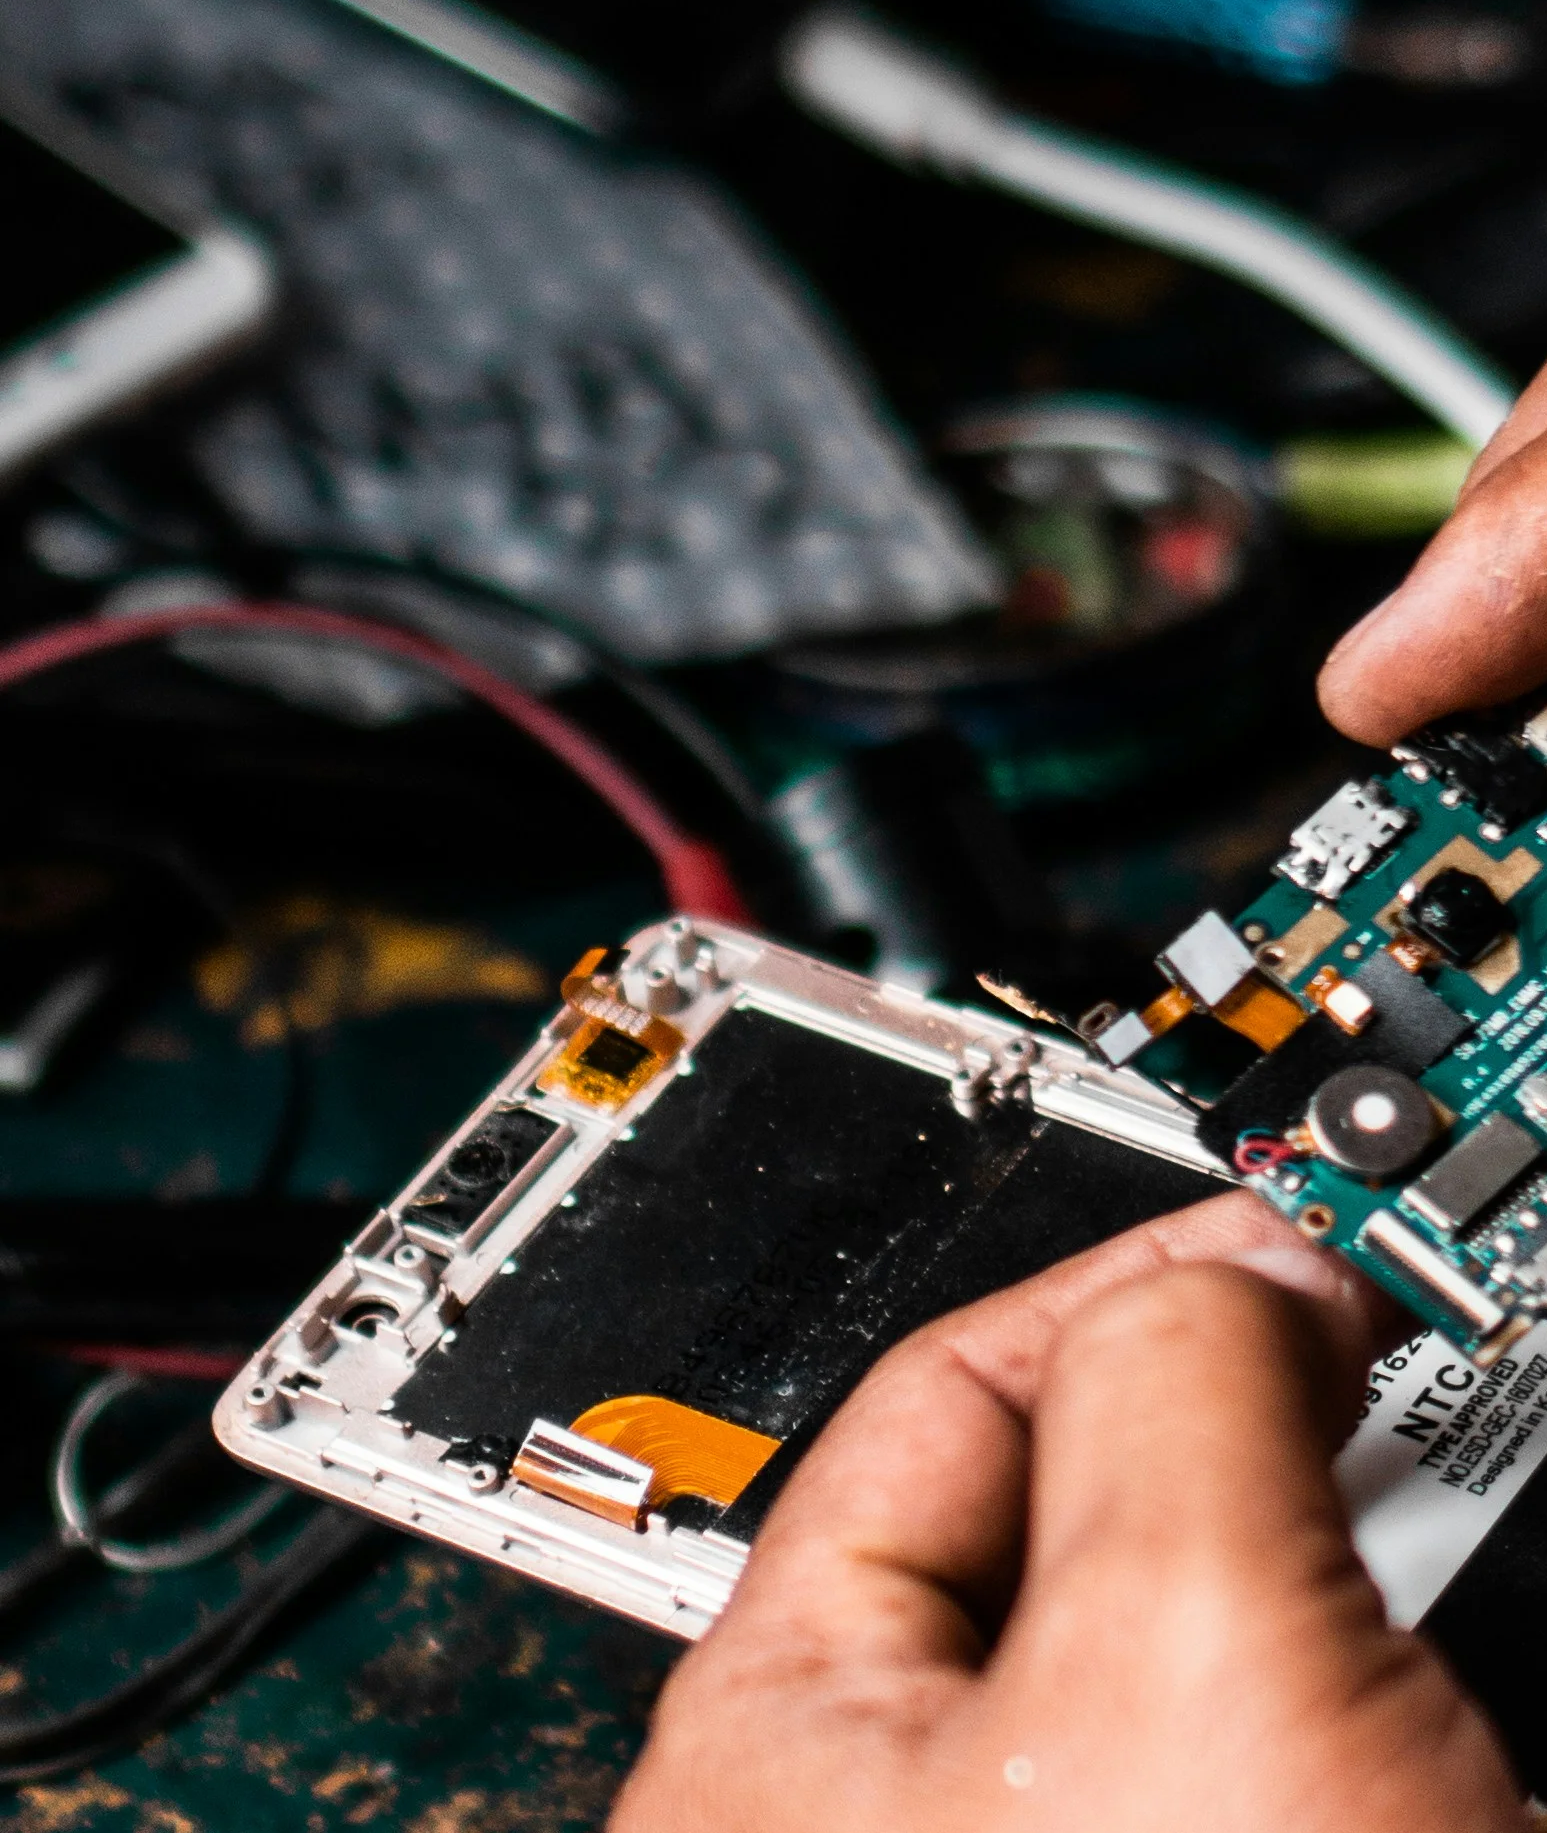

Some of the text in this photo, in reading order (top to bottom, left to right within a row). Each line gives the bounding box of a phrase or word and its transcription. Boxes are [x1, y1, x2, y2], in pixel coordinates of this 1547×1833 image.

[1392, 1364, 1474, 1443] NTC
[1417, 1358, 1519, 1470] TYPE APPROVED
[1467, 1422, 1532, 1496] Designed
[1521, 1410, 1540, 1428] in
